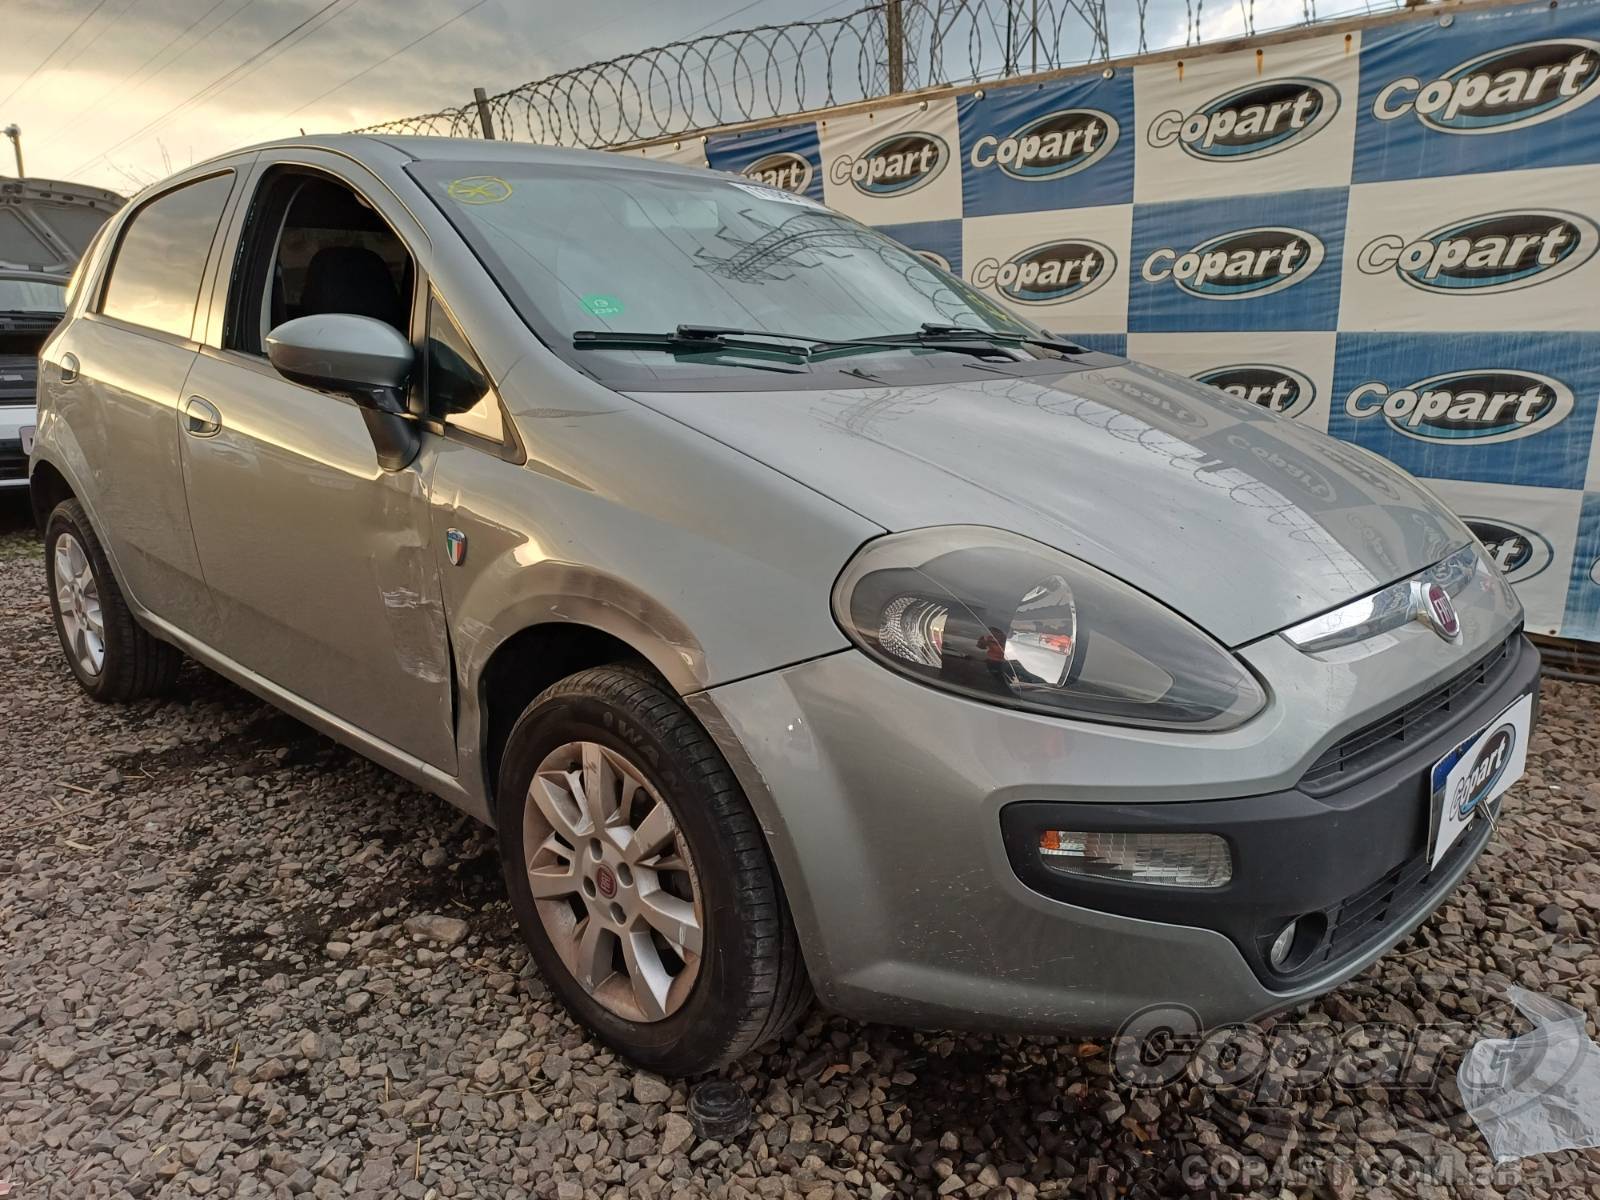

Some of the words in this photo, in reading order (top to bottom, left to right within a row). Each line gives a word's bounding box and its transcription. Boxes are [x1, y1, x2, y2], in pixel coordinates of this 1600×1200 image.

[1372, 52, 1590, 121] Copart
[1147, 88, 1317, 148] Copart
[830, 143, 933, 186] Copart
[971, 121, 1099, 169] Copart
[741, 161, 801, 191] part
[971, 252, 1097, 292] Copart
[1141, 238, 1305, 287] Copart
[1357, 223, 1571, 279] Copart
[1345, 382, 1545, 426] Copart
[1450, 736, 1506, 821] Copart
